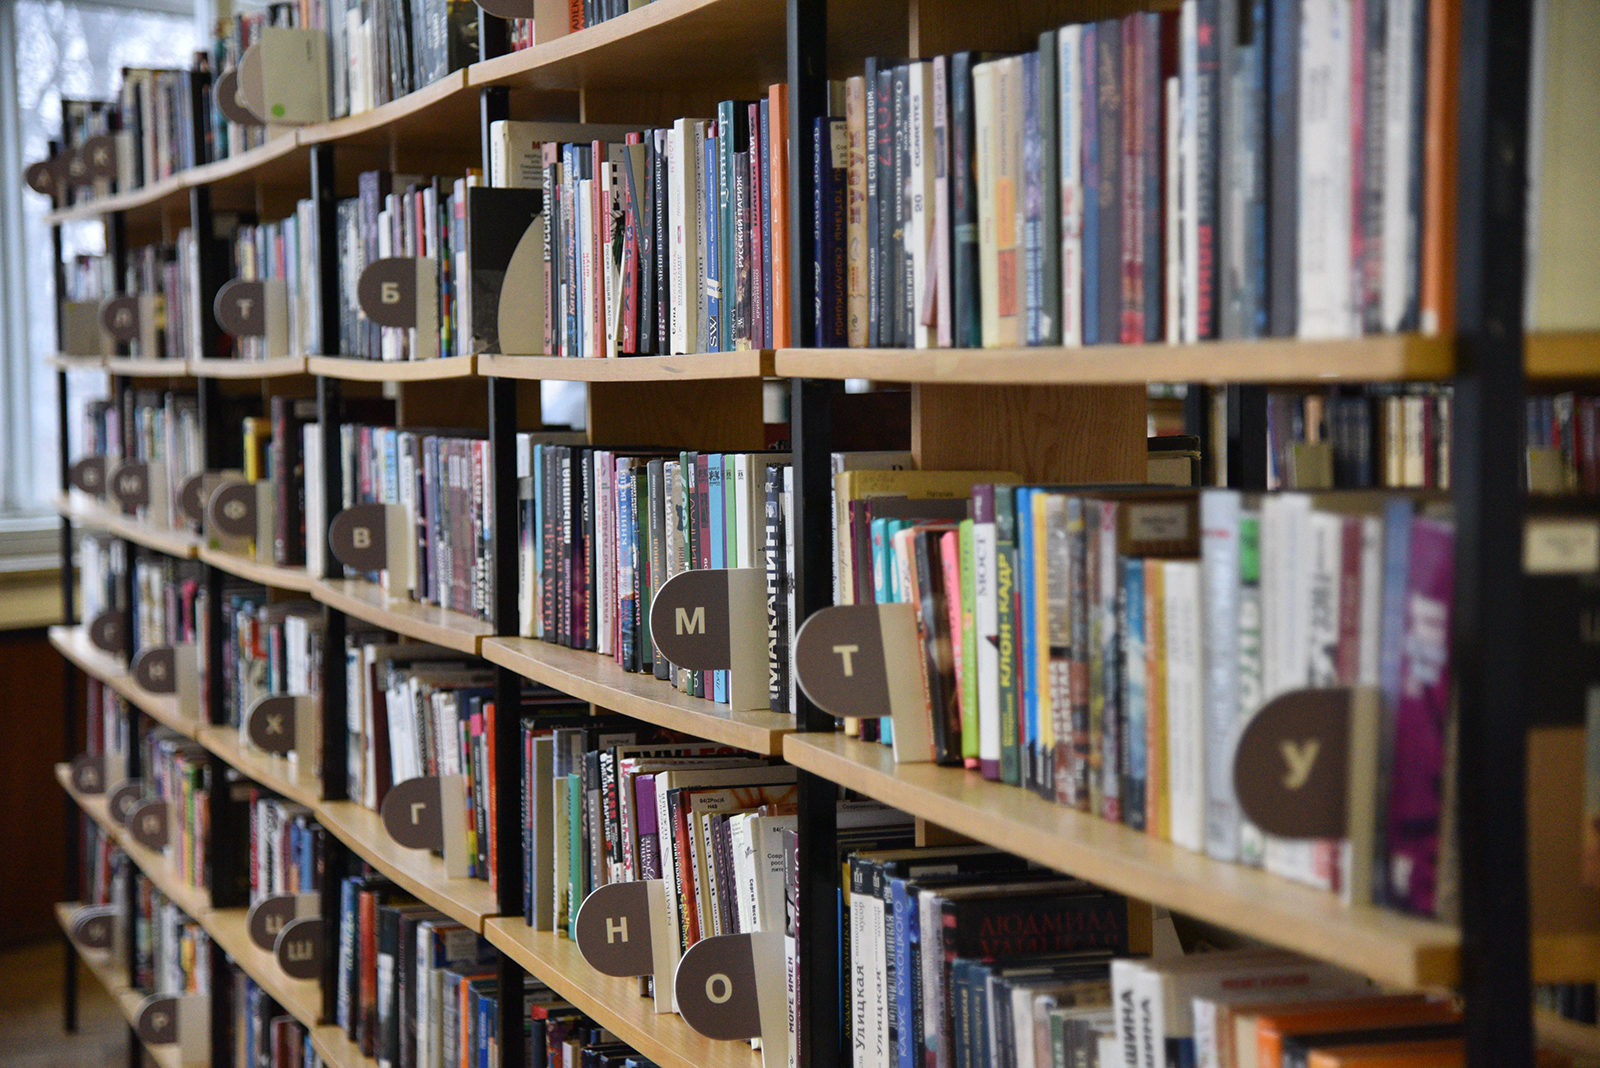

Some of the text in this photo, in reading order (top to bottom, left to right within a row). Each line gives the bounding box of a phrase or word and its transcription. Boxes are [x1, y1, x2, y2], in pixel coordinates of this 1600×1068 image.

[867, 80, 876, 196] НЕ СТОЙ ПОД НЕБОМ...
[913, 94, 921, 168] CIGARETTES
[381, 282, 400, 304] Б
[235, 298, 252, 320] Т
[352, 526, 371, 549] В
[674, 607, 706, 636] М
[766, 525, 778, 693] МАКАНИН
[832, 645, 859, 677] Т
[265, 712, 284, 736] Х
[600, 762, 608, 793] MEDIA
[1280, 737, 1321, 791] У
[410, 802, 427, 825] Г
[606, 915, 629, 944] Н
[980, 911, 1120, 937] ЛЮДМИЛА
[287, 941, 313, 961] Ш
[704, 972, 733, 1004] О
[895, 900, 908, 1058] КАЗУС КУКОЦКОГО
[787, 956, 797, 1034] МОРЕ ИМЕН
[854, 965, 867, 1052] Улицкая
[873, 970, 885, 1058] Улицкая
